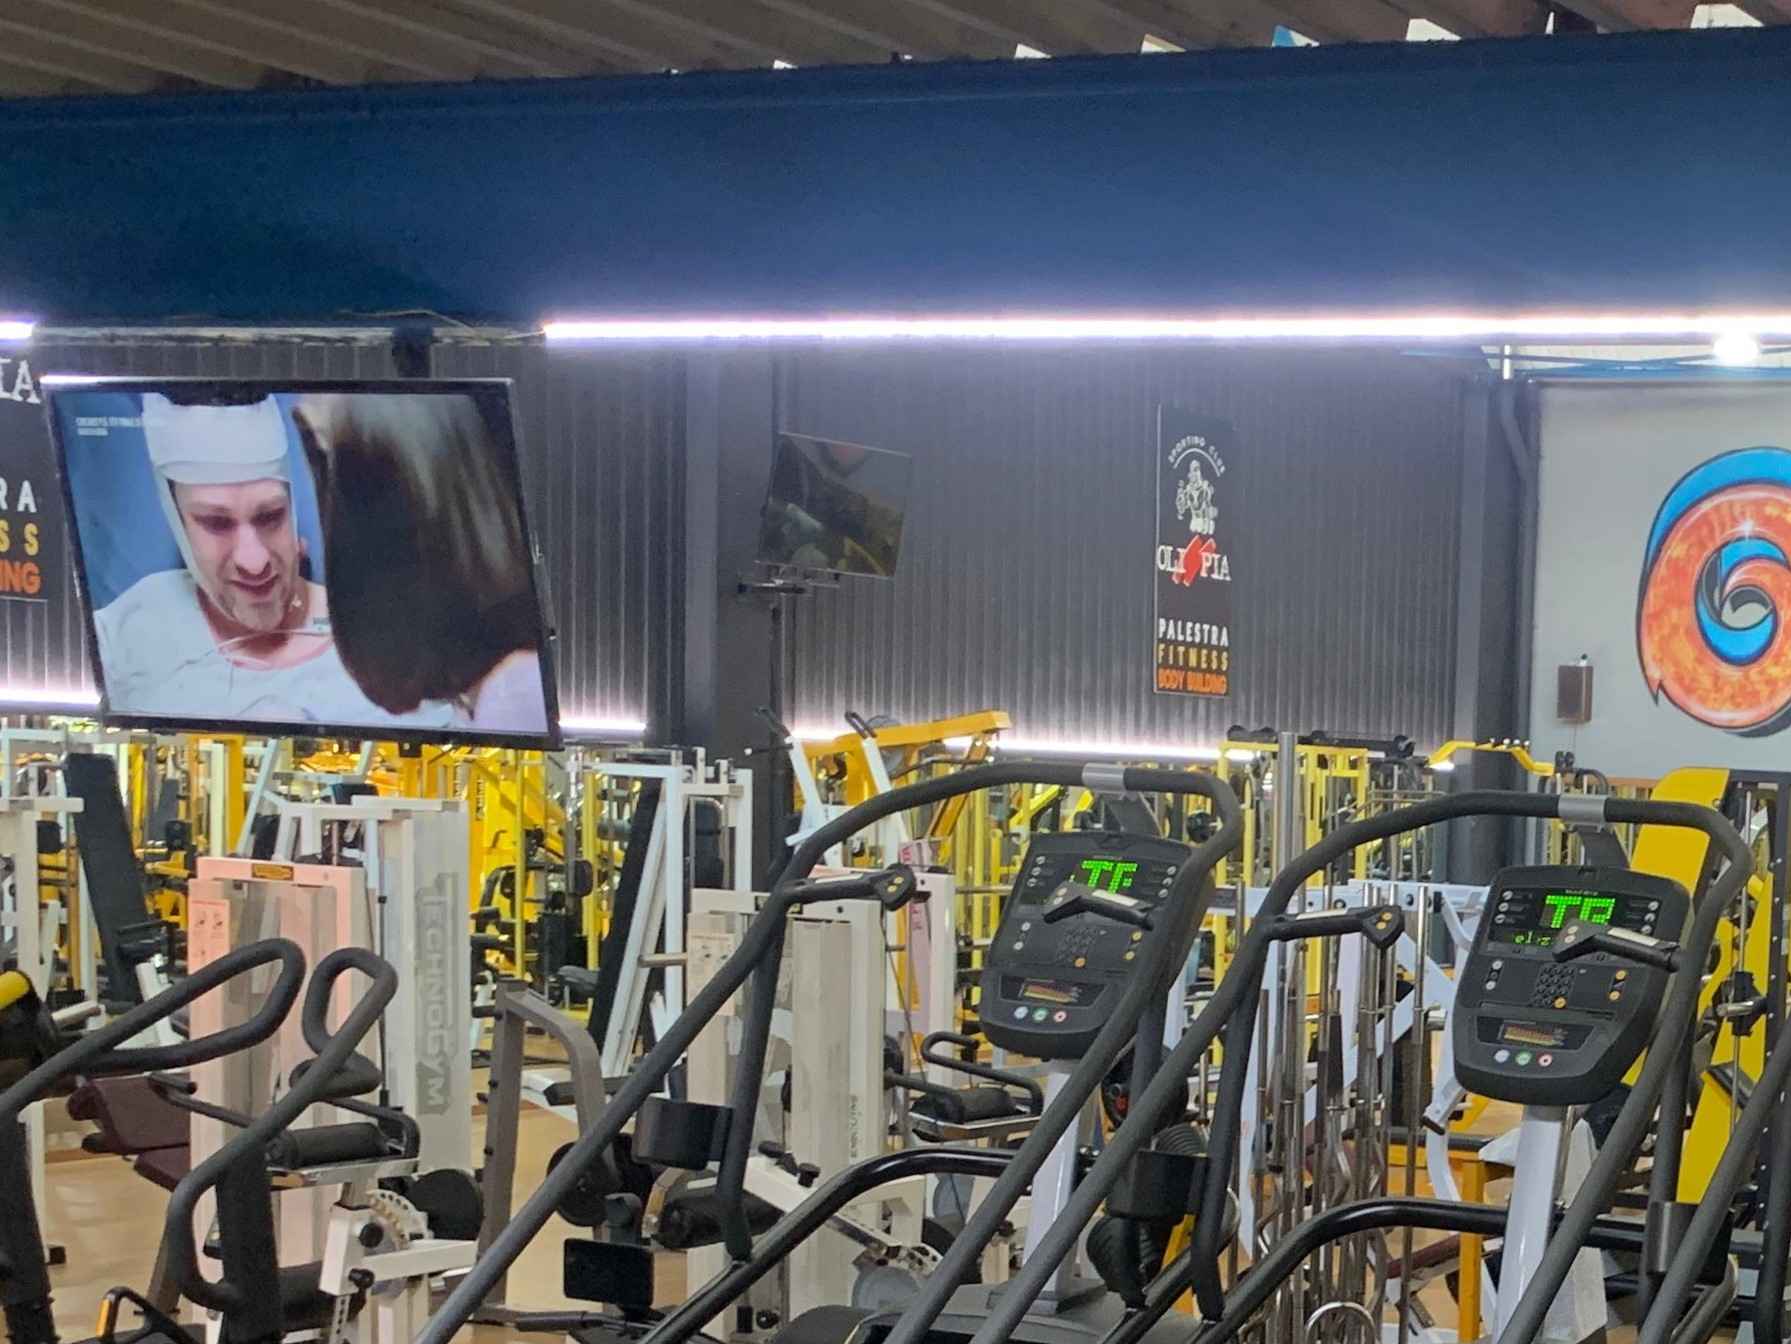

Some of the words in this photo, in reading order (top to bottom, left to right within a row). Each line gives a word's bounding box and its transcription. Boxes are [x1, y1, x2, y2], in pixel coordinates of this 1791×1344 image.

[1158, 618, 1229, 648] PALESTRA
[1157, 643, 1229, 672] FITNESS
[422, 876, 456, 1107] TECHNOGYM
